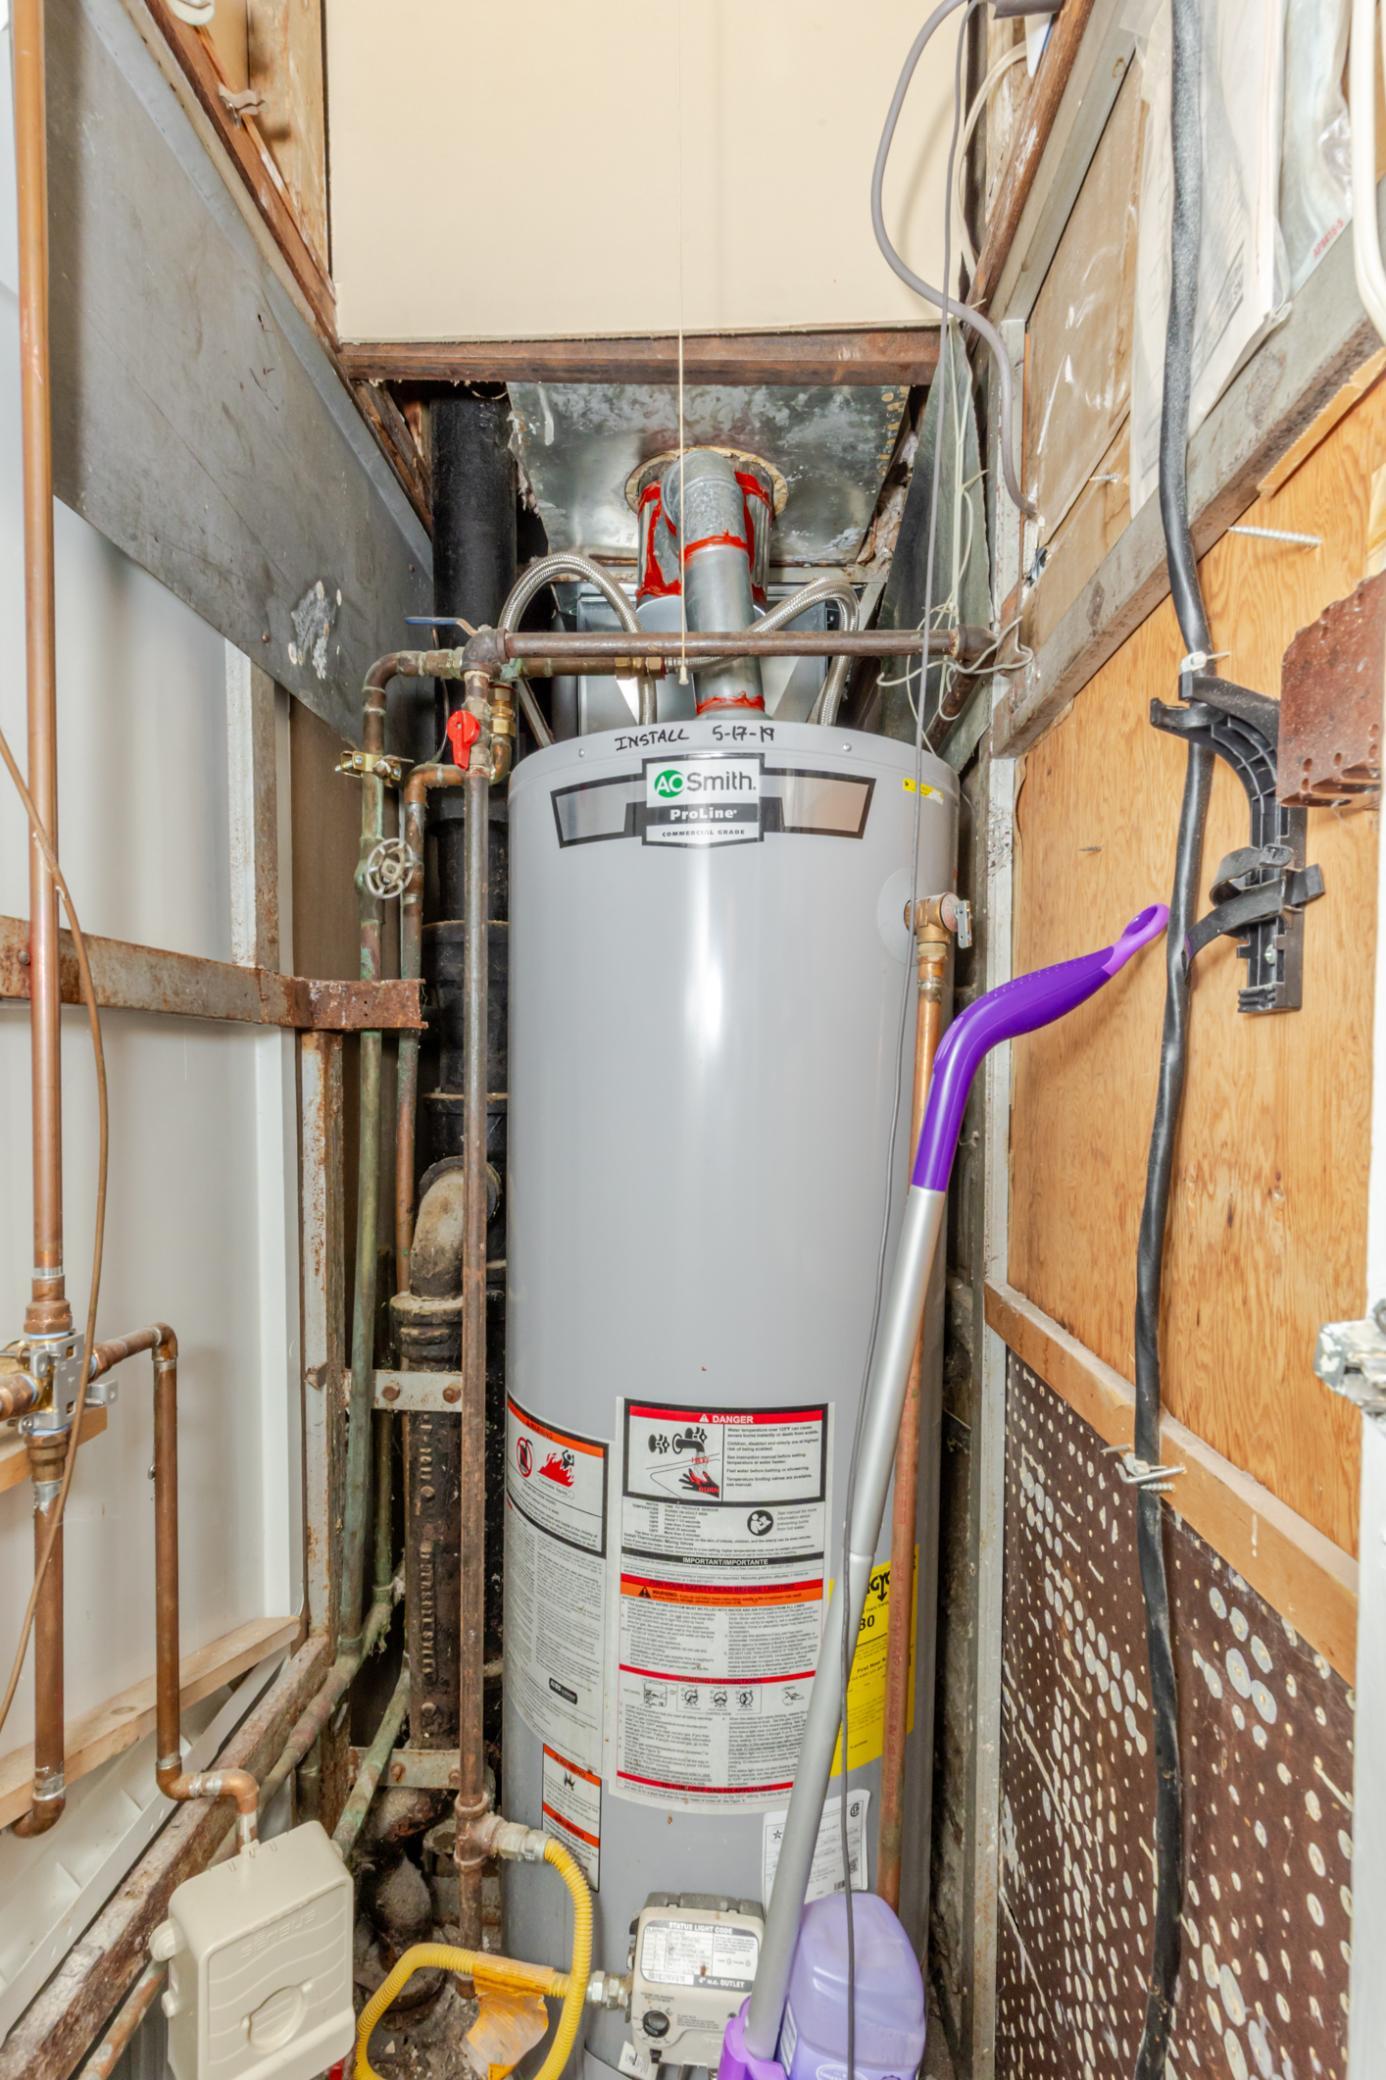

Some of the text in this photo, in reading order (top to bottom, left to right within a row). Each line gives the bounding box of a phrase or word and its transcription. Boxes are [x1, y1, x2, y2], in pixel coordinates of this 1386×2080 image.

[615, 725, 775, 751] INSTALL 5-17-19
[712, 1415, 754, 1424] DANGER
[669, 1922, 693, 1931] STATUS
[695, 1924, 714, 1932] LIGHT
